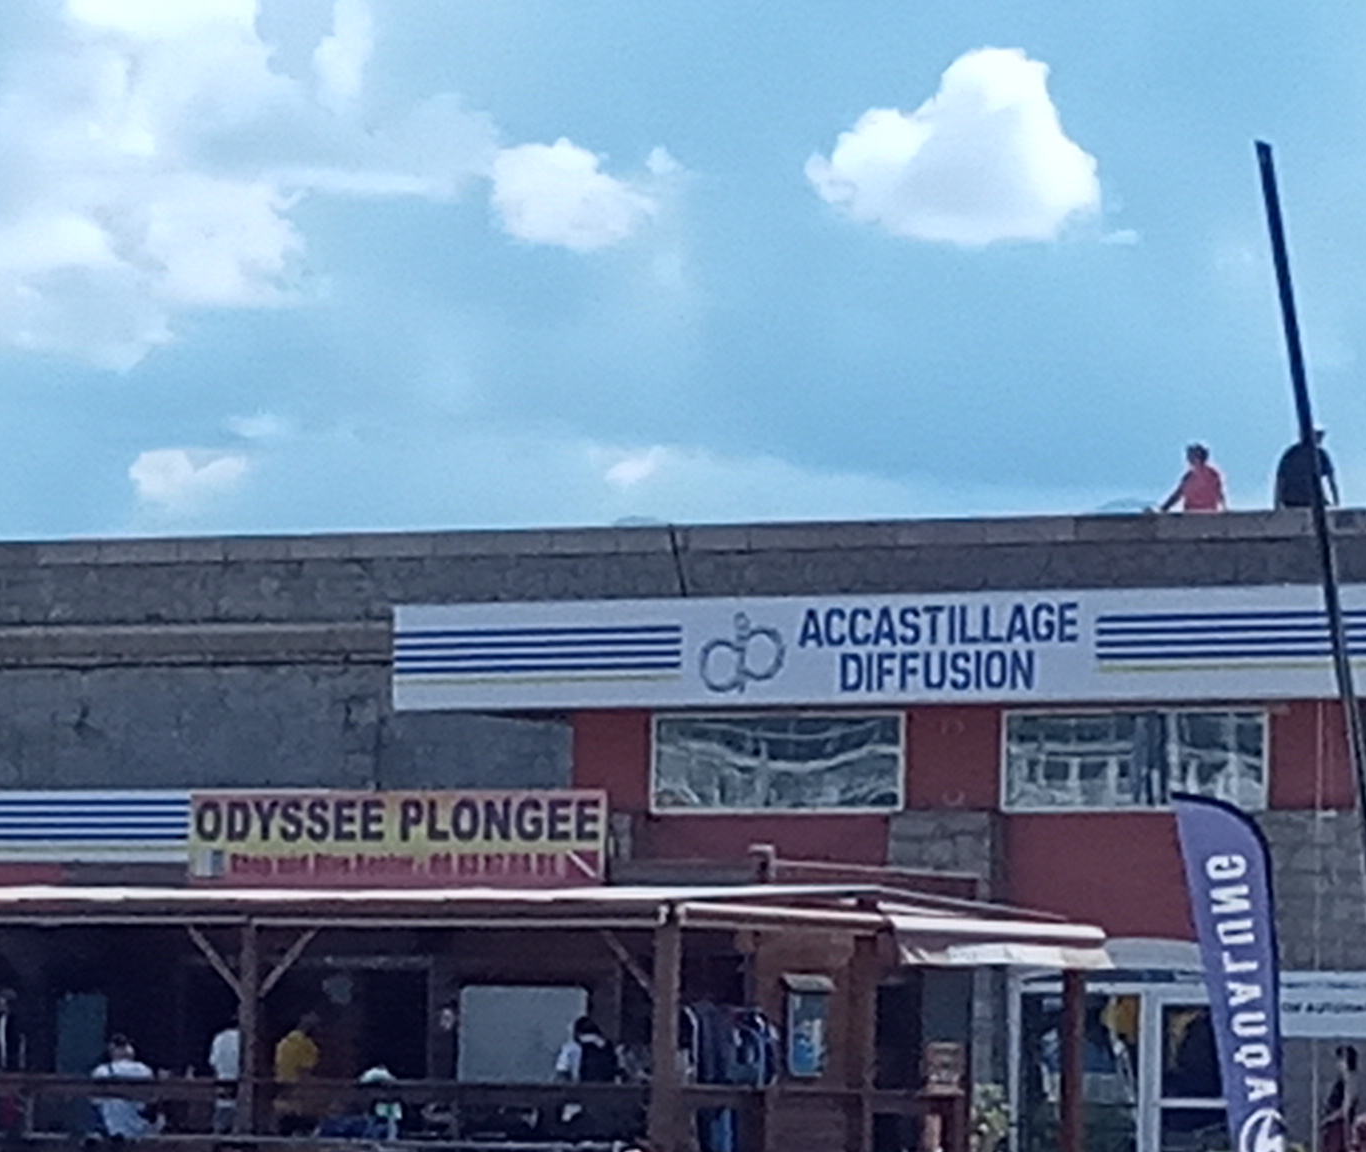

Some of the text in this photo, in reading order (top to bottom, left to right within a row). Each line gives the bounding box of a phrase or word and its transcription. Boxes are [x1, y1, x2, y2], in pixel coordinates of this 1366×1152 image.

[798, 603, 1079, 648] ACCASTILLAGE
[839, 650, 1035, 692] DIFFUSION
[194, 799, 600, 842] ODYSSEE PLONGEE
